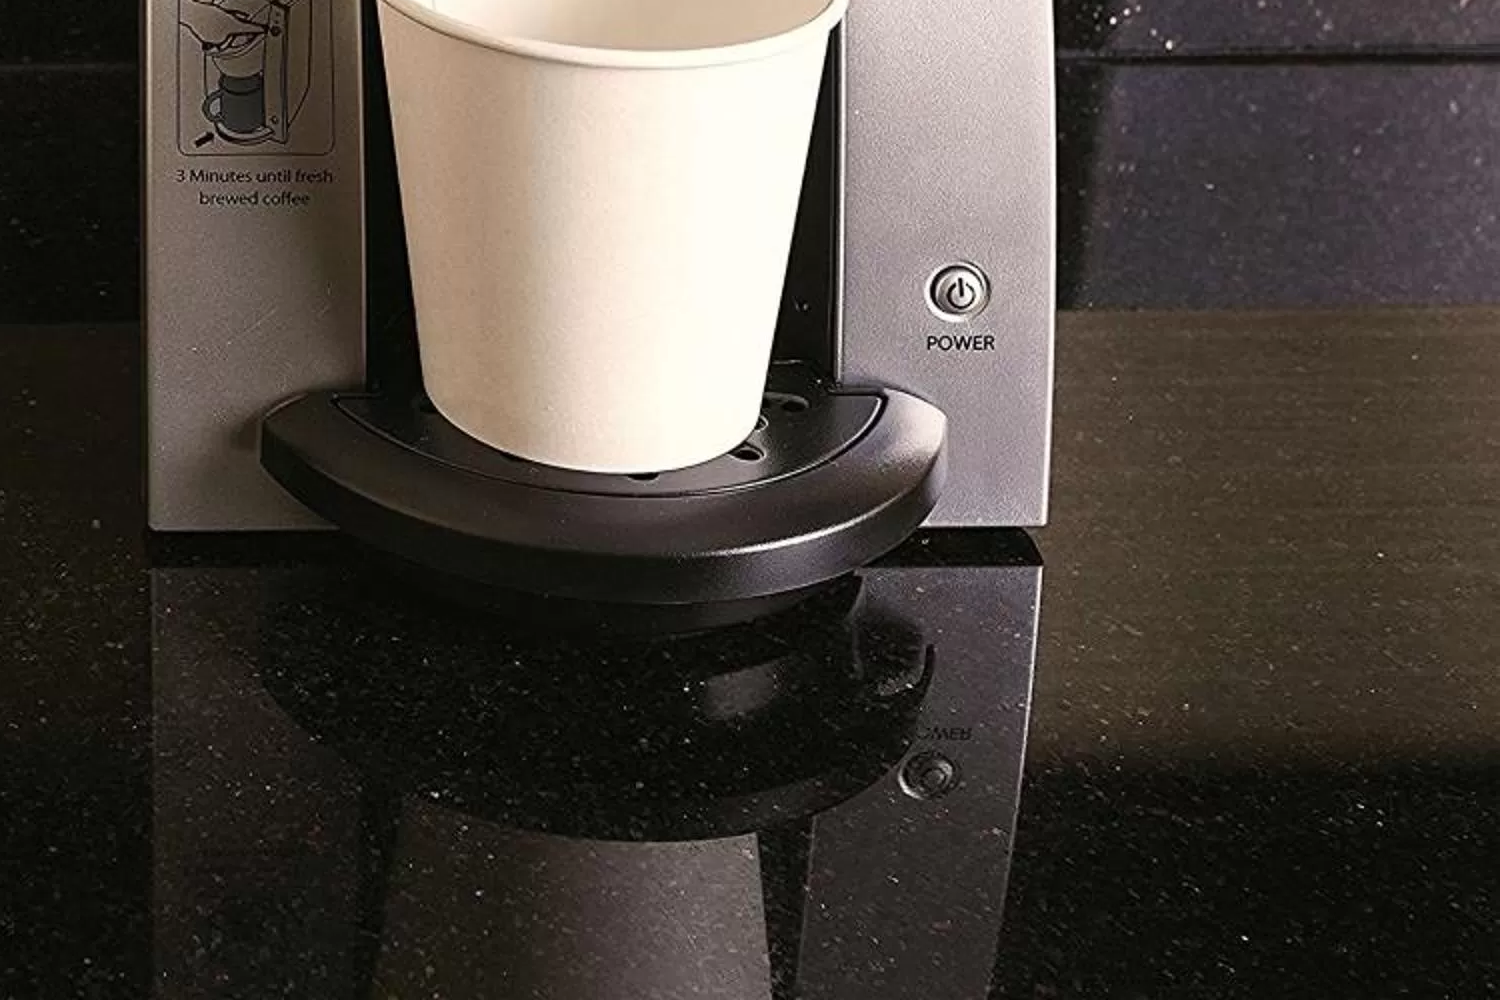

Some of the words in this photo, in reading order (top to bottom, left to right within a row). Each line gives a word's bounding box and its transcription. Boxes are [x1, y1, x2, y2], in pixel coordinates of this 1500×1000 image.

[176, 169, 186, 183] 3
[189, 169, 251, 184] Minutes
[255, 169, 291, 184] until
[295, 169, 334, 184] fresh
[199, 191, 259, 206] brewed
[262, 191, 311, 206] coffee
[926, 335, 996, 351] POWER
